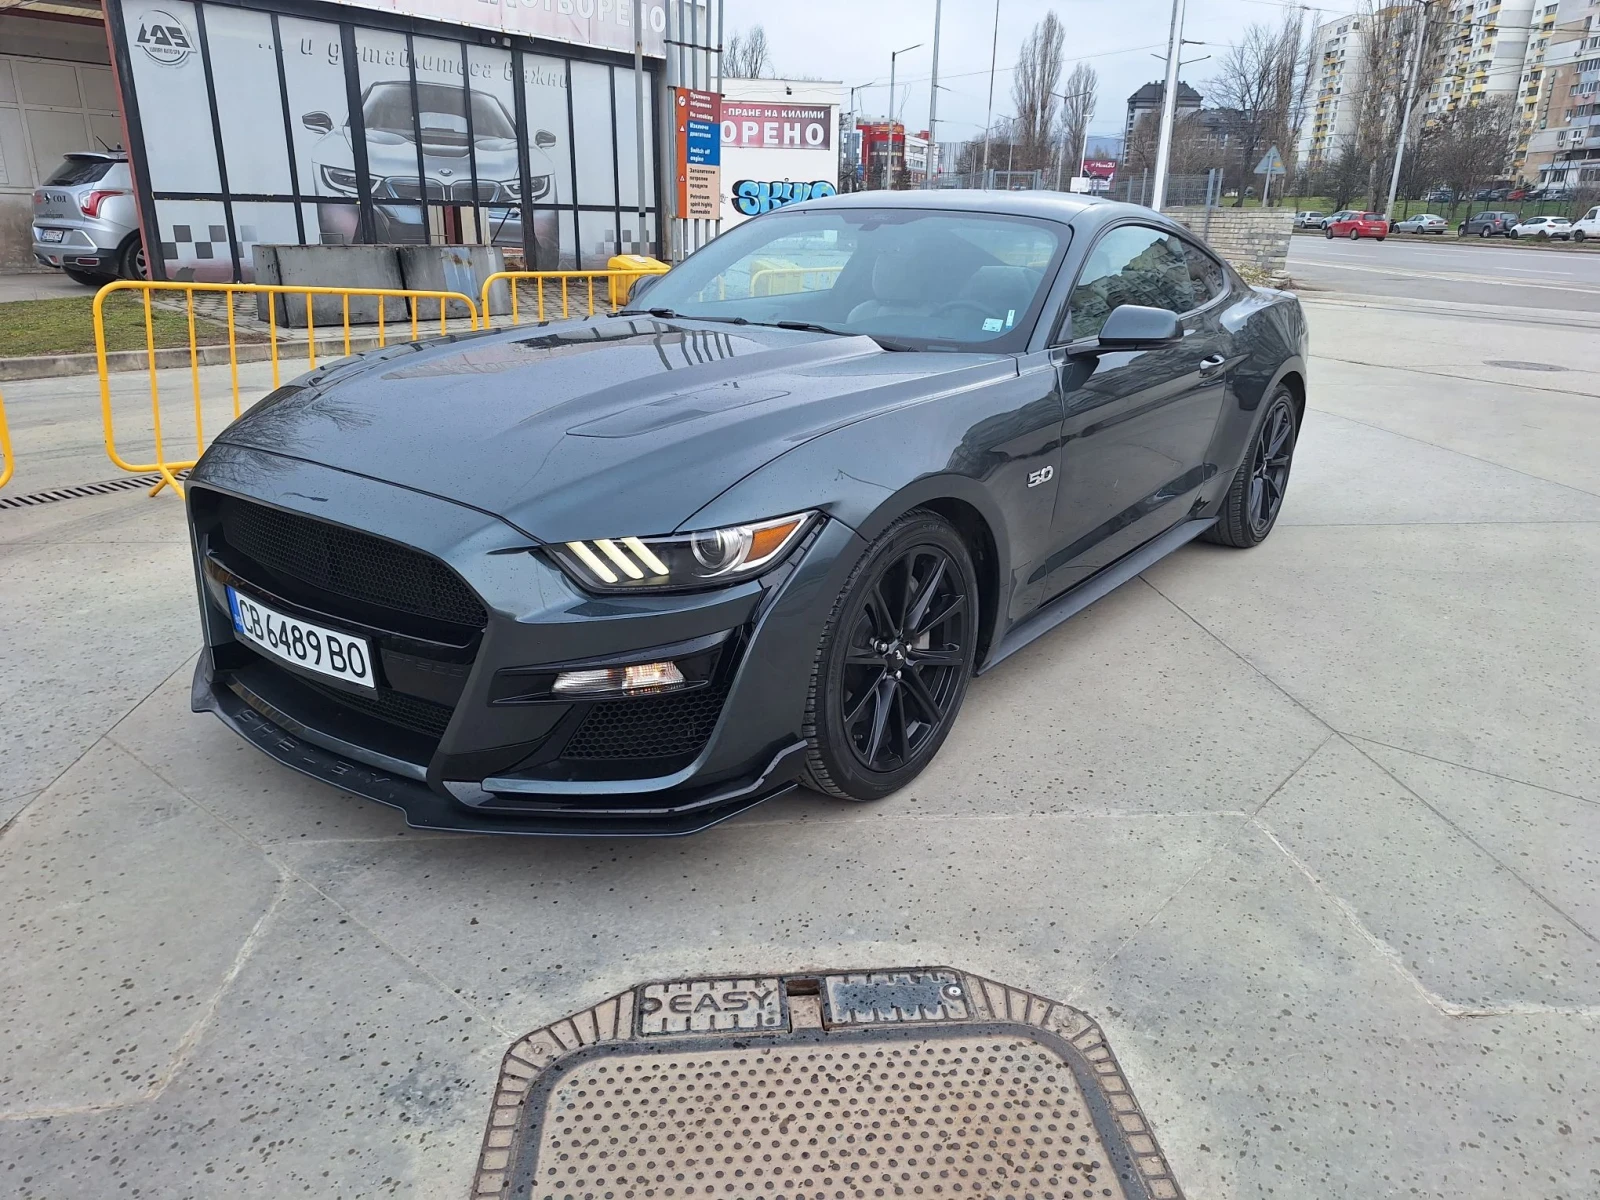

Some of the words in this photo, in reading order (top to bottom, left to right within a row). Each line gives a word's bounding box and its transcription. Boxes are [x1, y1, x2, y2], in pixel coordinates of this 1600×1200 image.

[137, 23, 191, 48] LAS
[696, 113, 713, 122] smoking
[728, 108, 761, 117] ПРАНЕ
[764, 109, 778, 118] НА
[781, 110, 825, 119] КИЛИМИ
[690, 146, 704, 154] Switch
[690, 155, 704, 163] engine
[701, 201, 713, 209] highly
